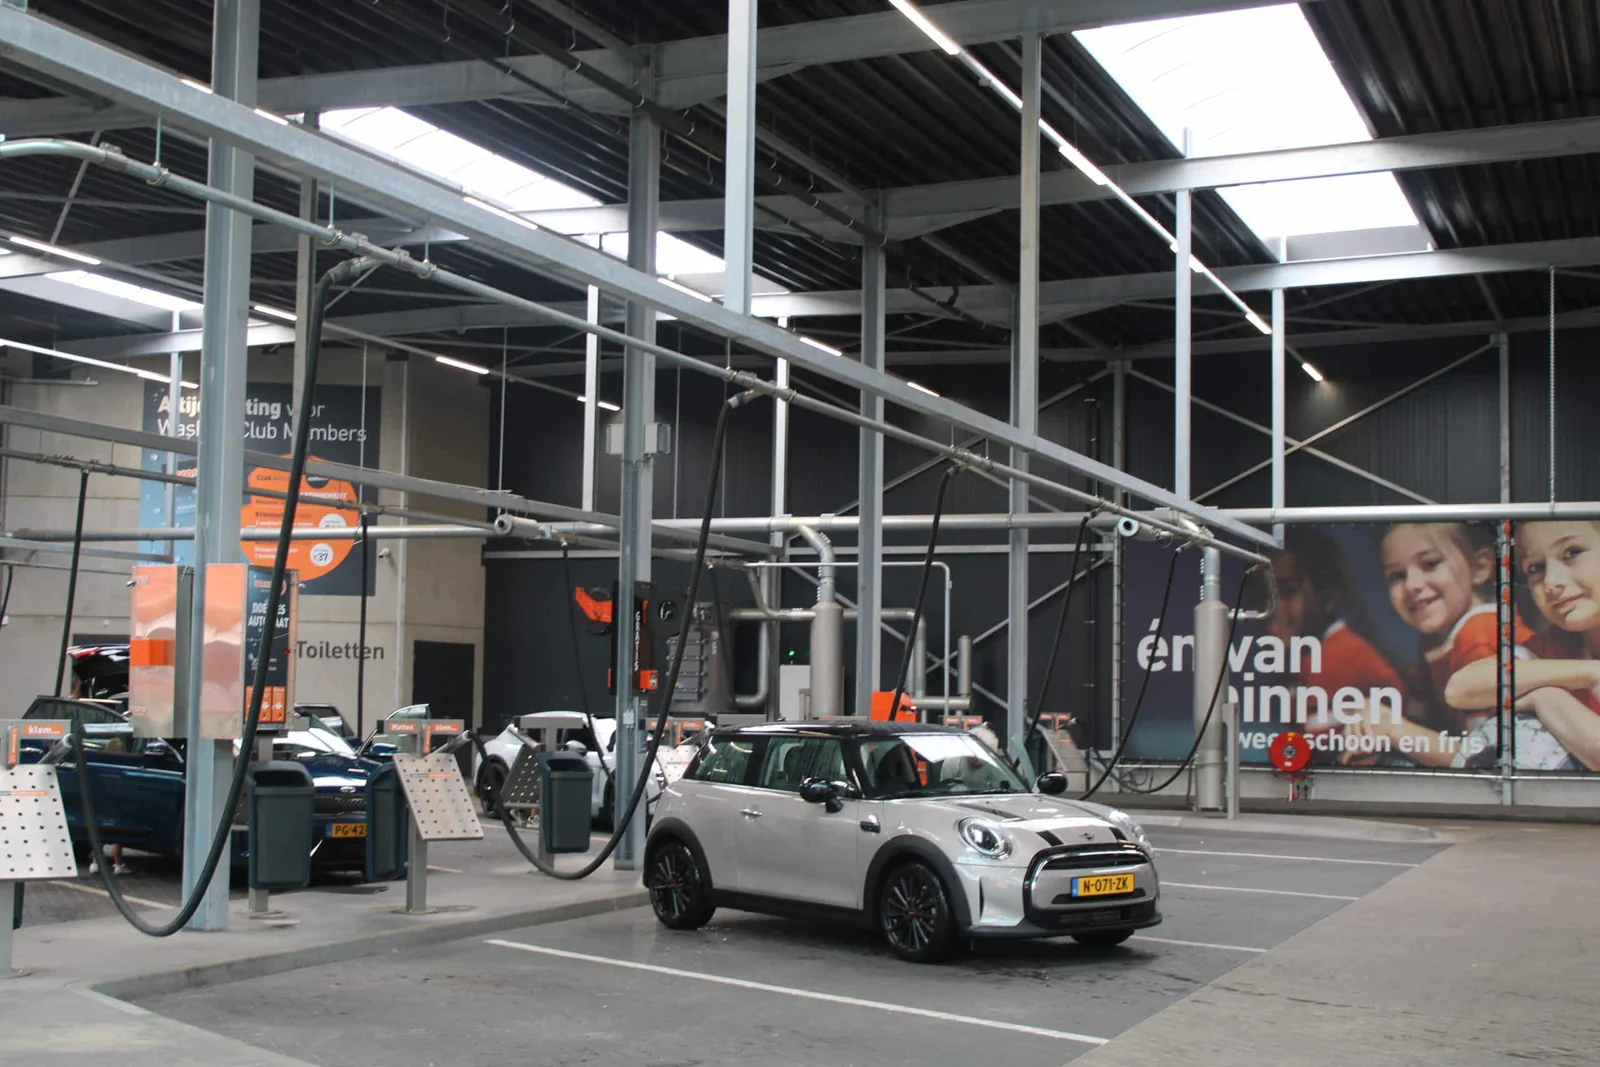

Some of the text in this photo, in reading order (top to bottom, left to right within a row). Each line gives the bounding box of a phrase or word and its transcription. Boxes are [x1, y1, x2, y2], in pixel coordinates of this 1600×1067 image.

[245, 398, 281, 420] ting
[283, 422, 367, 442] Mmbers
[296, 641, 384, 659] Toiletten
[1228, 635, 1322, 673] van
[1228, 672, 1403, 725] innen
[1303, 728, 1390, 753] schoon
[1398, 735, 1430, 753] en
[1437, 730, 1485, 754] fris
[335, 824, 365, 836] PG-42
[1083, 877, 1129, 893] N-071-ZK
